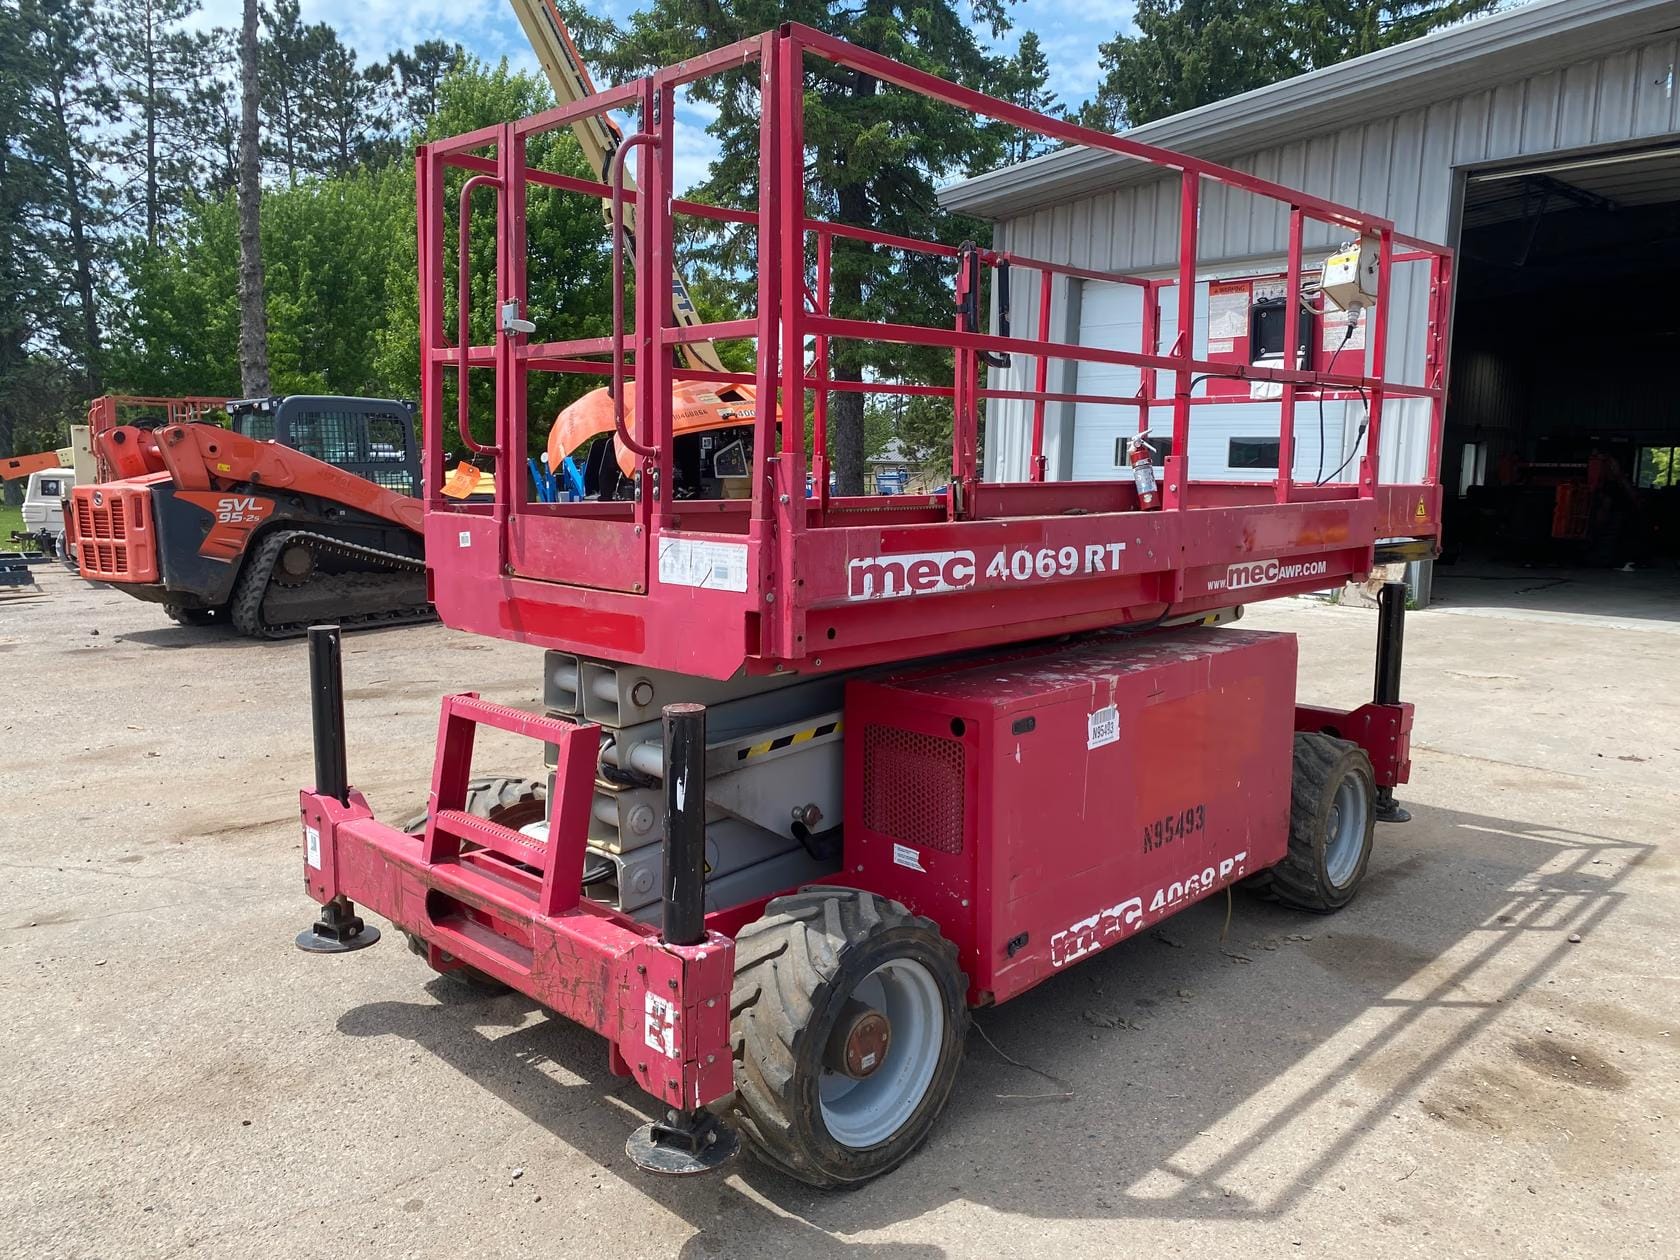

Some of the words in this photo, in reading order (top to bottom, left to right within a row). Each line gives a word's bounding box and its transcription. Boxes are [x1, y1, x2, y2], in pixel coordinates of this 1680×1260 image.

[216, 498, 263, 512] SVL
[848, 553, 976, 600] mec
[986, 547, 1079, 582] 4069
[1144, 804, 1205, 854] N95493
